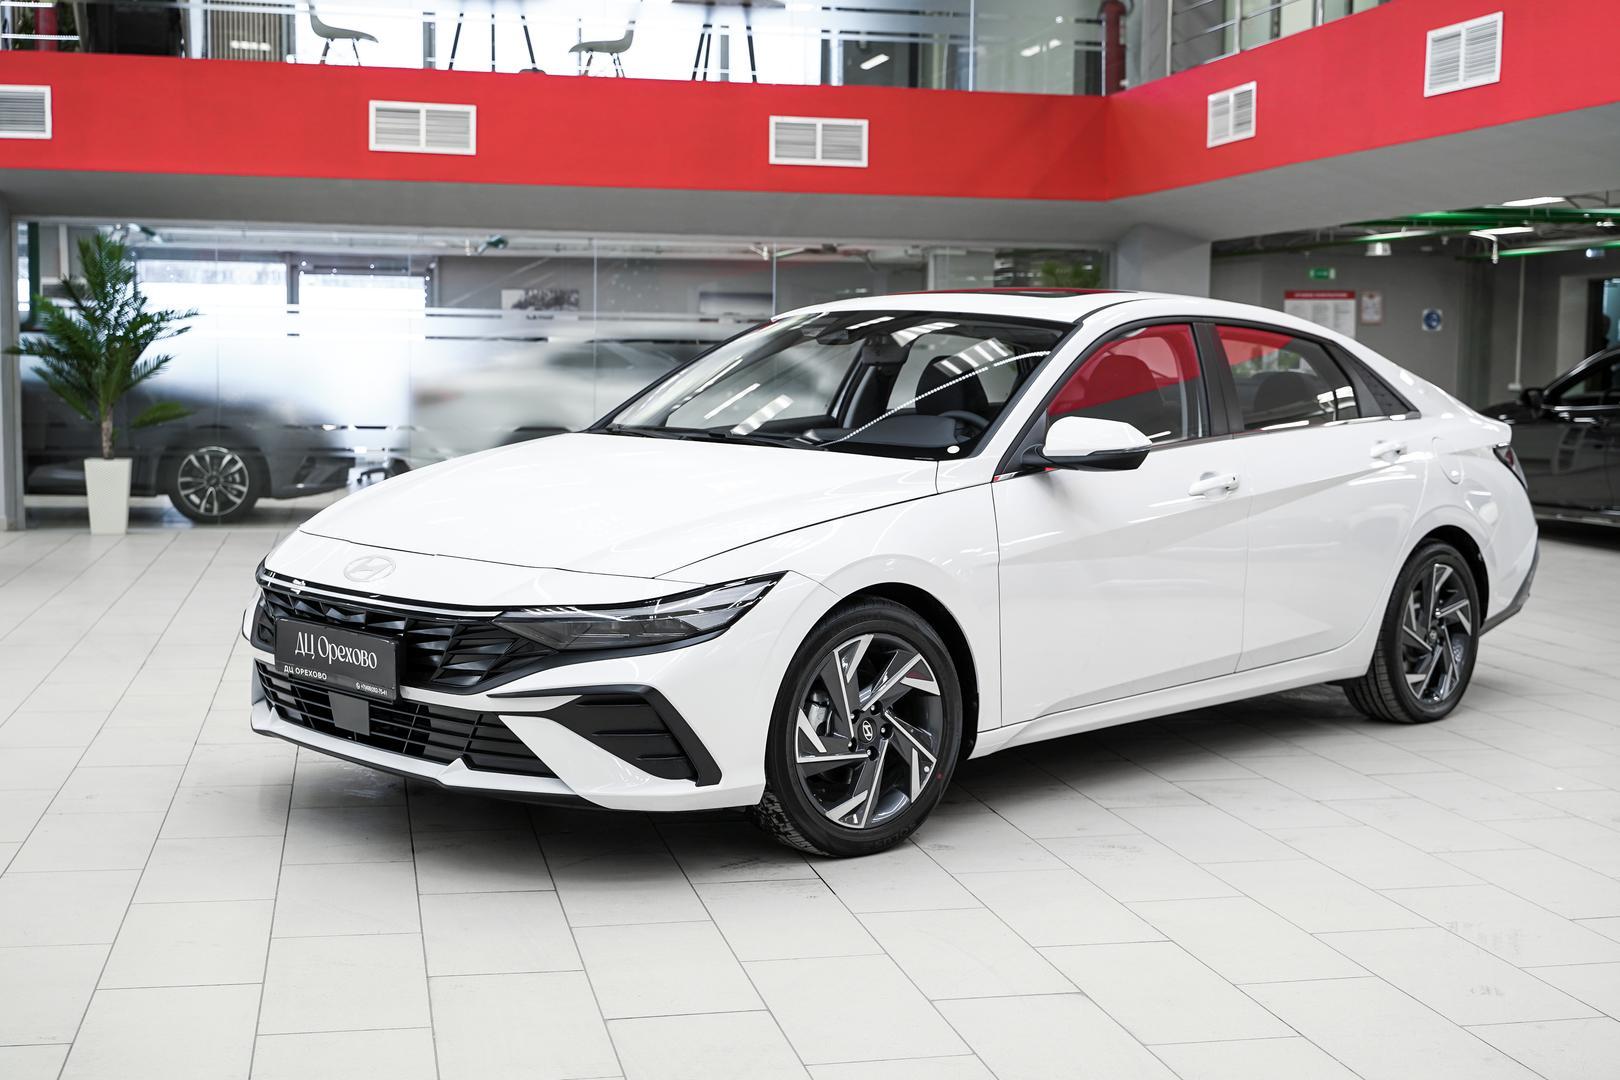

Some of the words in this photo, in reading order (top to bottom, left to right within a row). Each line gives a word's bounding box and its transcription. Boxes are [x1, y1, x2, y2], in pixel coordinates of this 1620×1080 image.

[295, 632, 315, 659] ДЦ
[317, 635, 378, 669] Орехово
[284, 665, 294, 674] ДЦ
[295, 668, 327, 680] ОРЕХОВО
